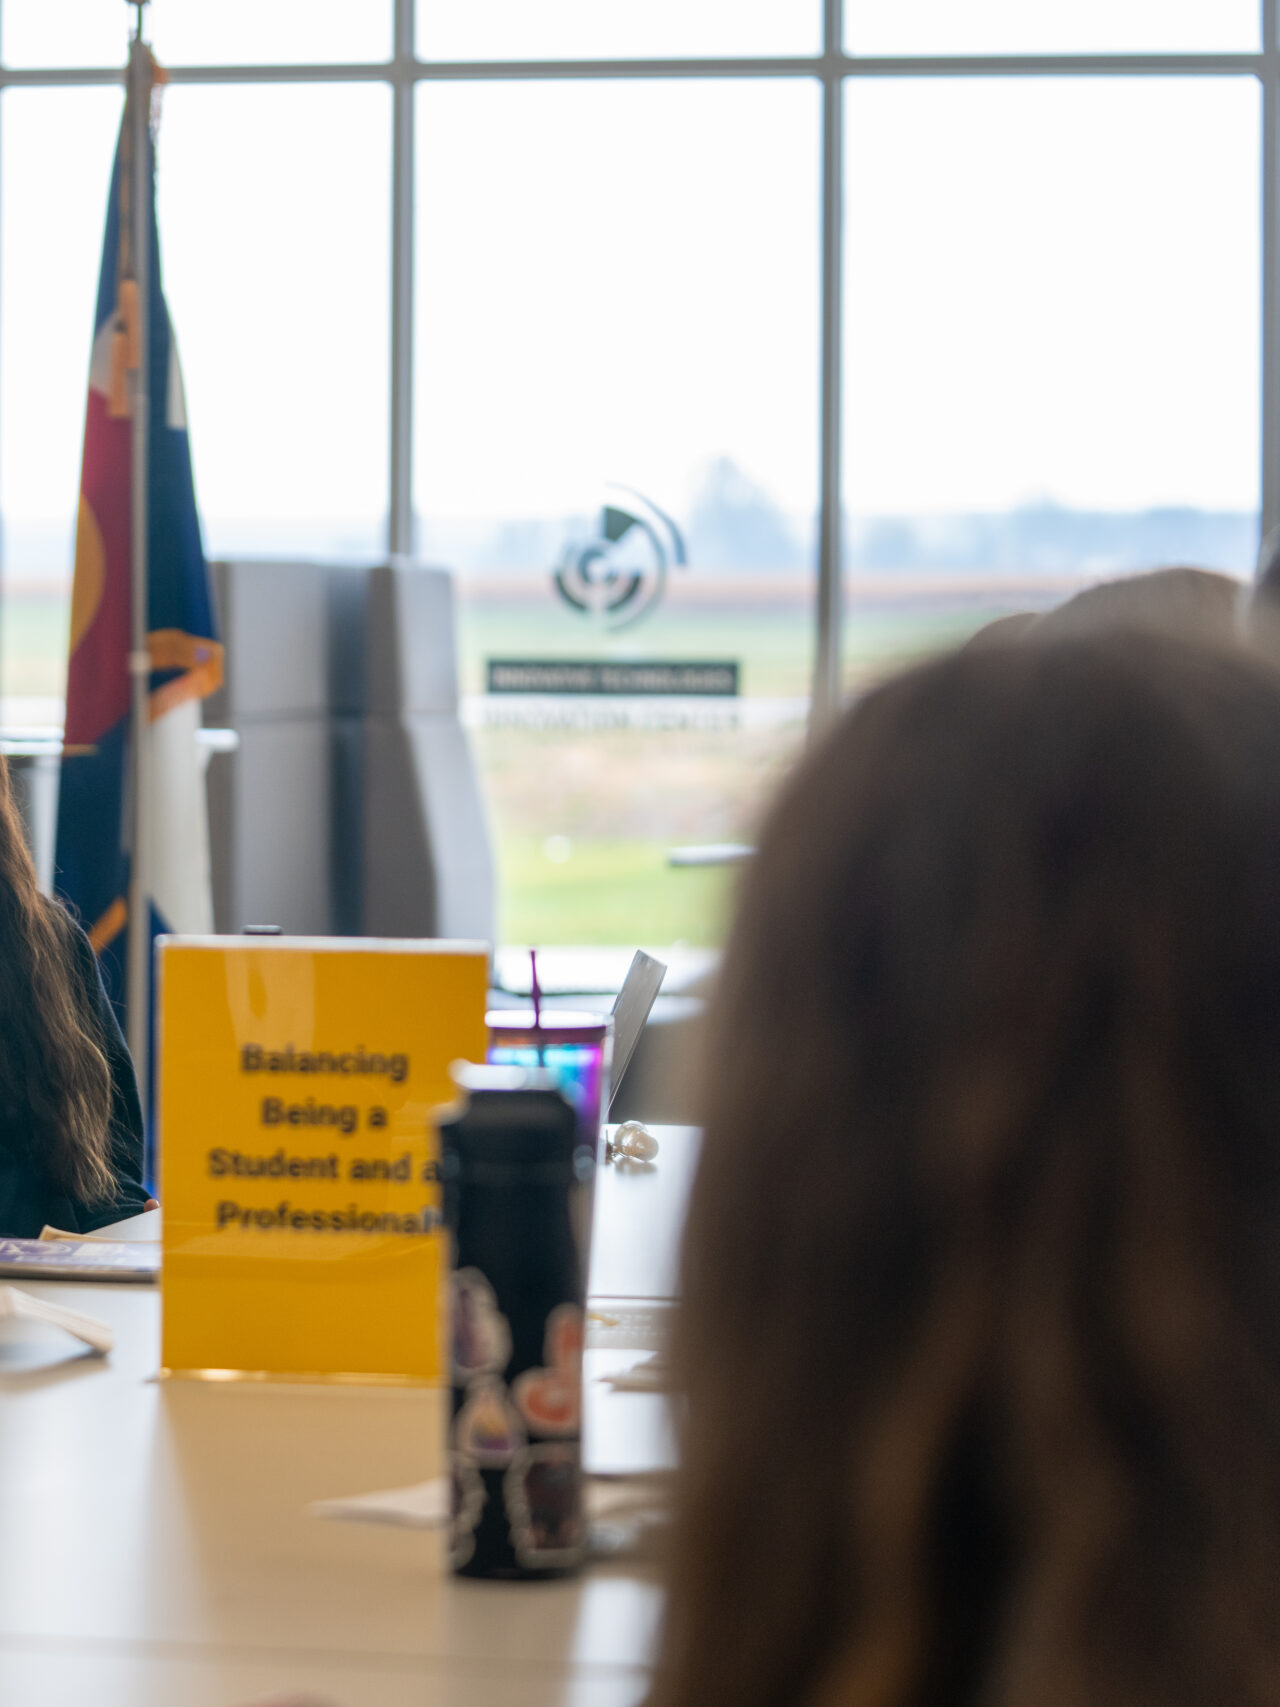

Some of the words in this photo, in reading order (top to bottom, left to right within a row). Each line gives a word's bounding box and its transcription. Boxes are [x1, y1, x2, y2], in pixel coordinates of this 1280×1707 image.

[242, 1043, 409, 1083] Balancing
[261, 1097, 358, 1135] Being
[368, 1106, 387, 1128] a
[209, 1148, 338, 1178] Student
[350, 1152, 412, 1181] and
[422, 1161, 441, 1181] a
[216, 1201, 434, 1234] Professional
